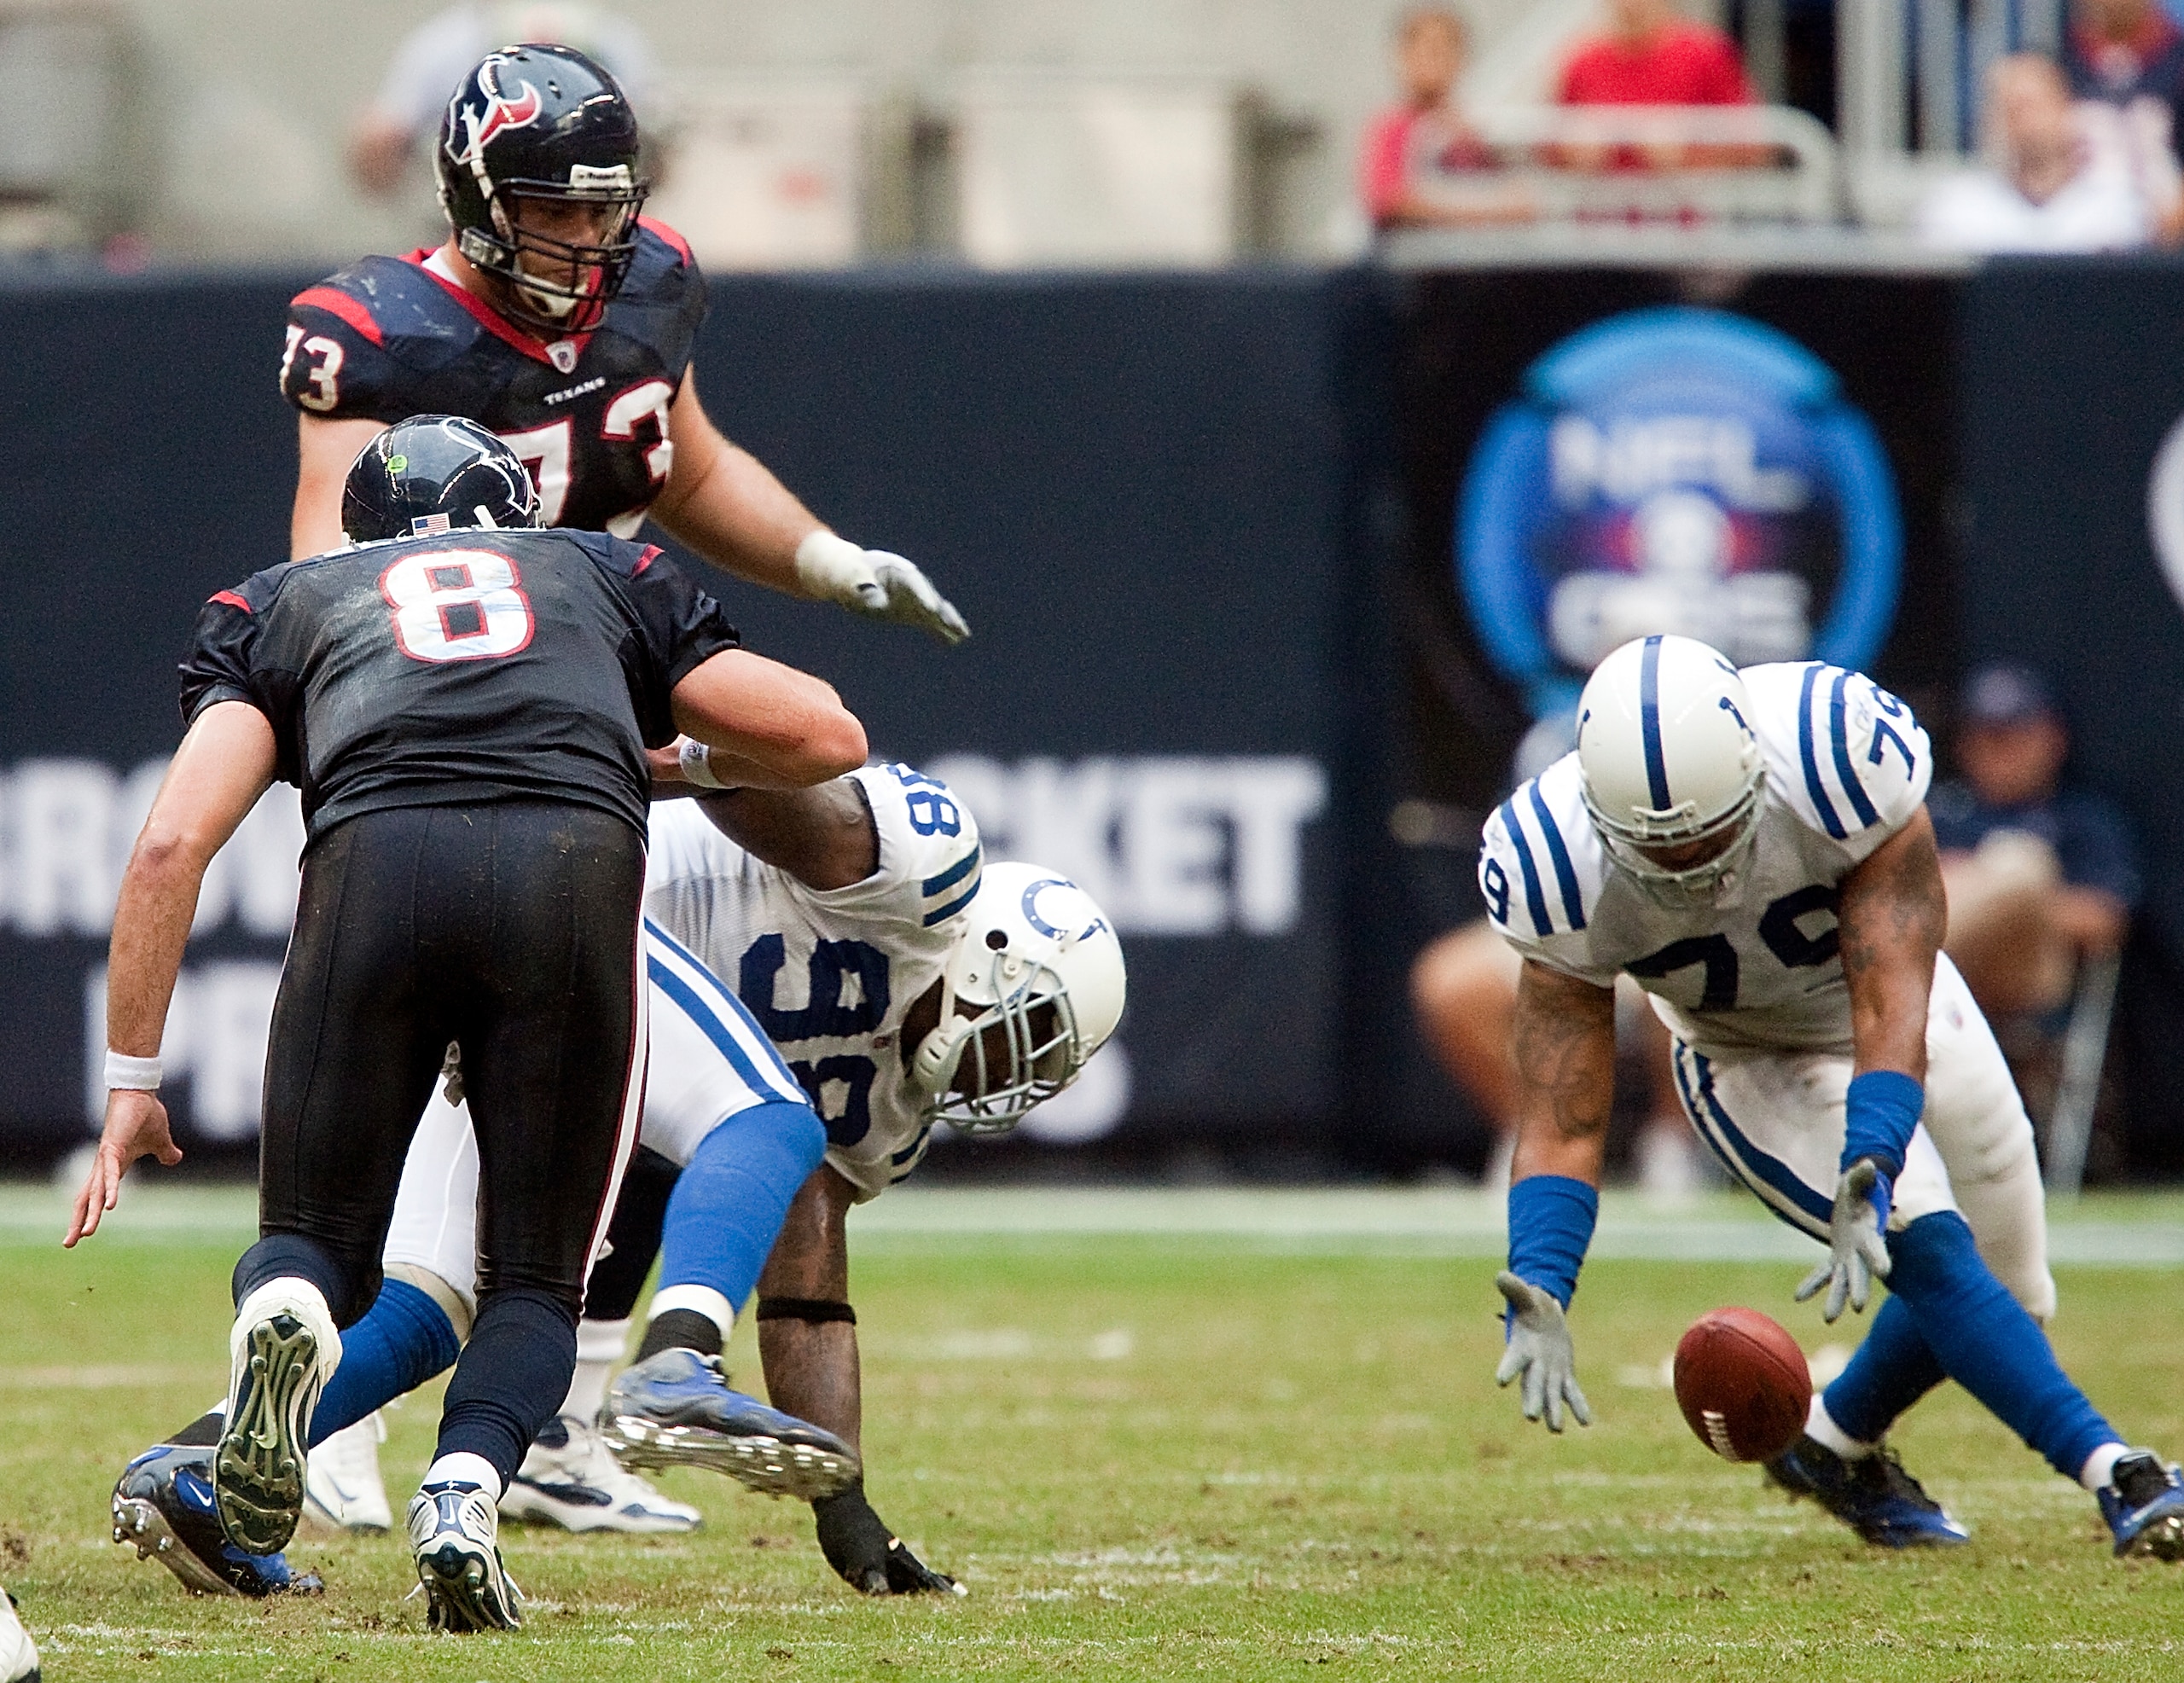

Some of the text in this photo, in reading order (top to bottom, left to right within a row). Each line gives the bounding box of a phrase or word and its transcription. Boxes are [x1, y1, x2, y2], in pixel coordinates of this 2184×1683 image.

[279, 323, 343, 411] 73
[543, 376, 606, 405] TEXANS
[379, 547, 535, 663] 8
